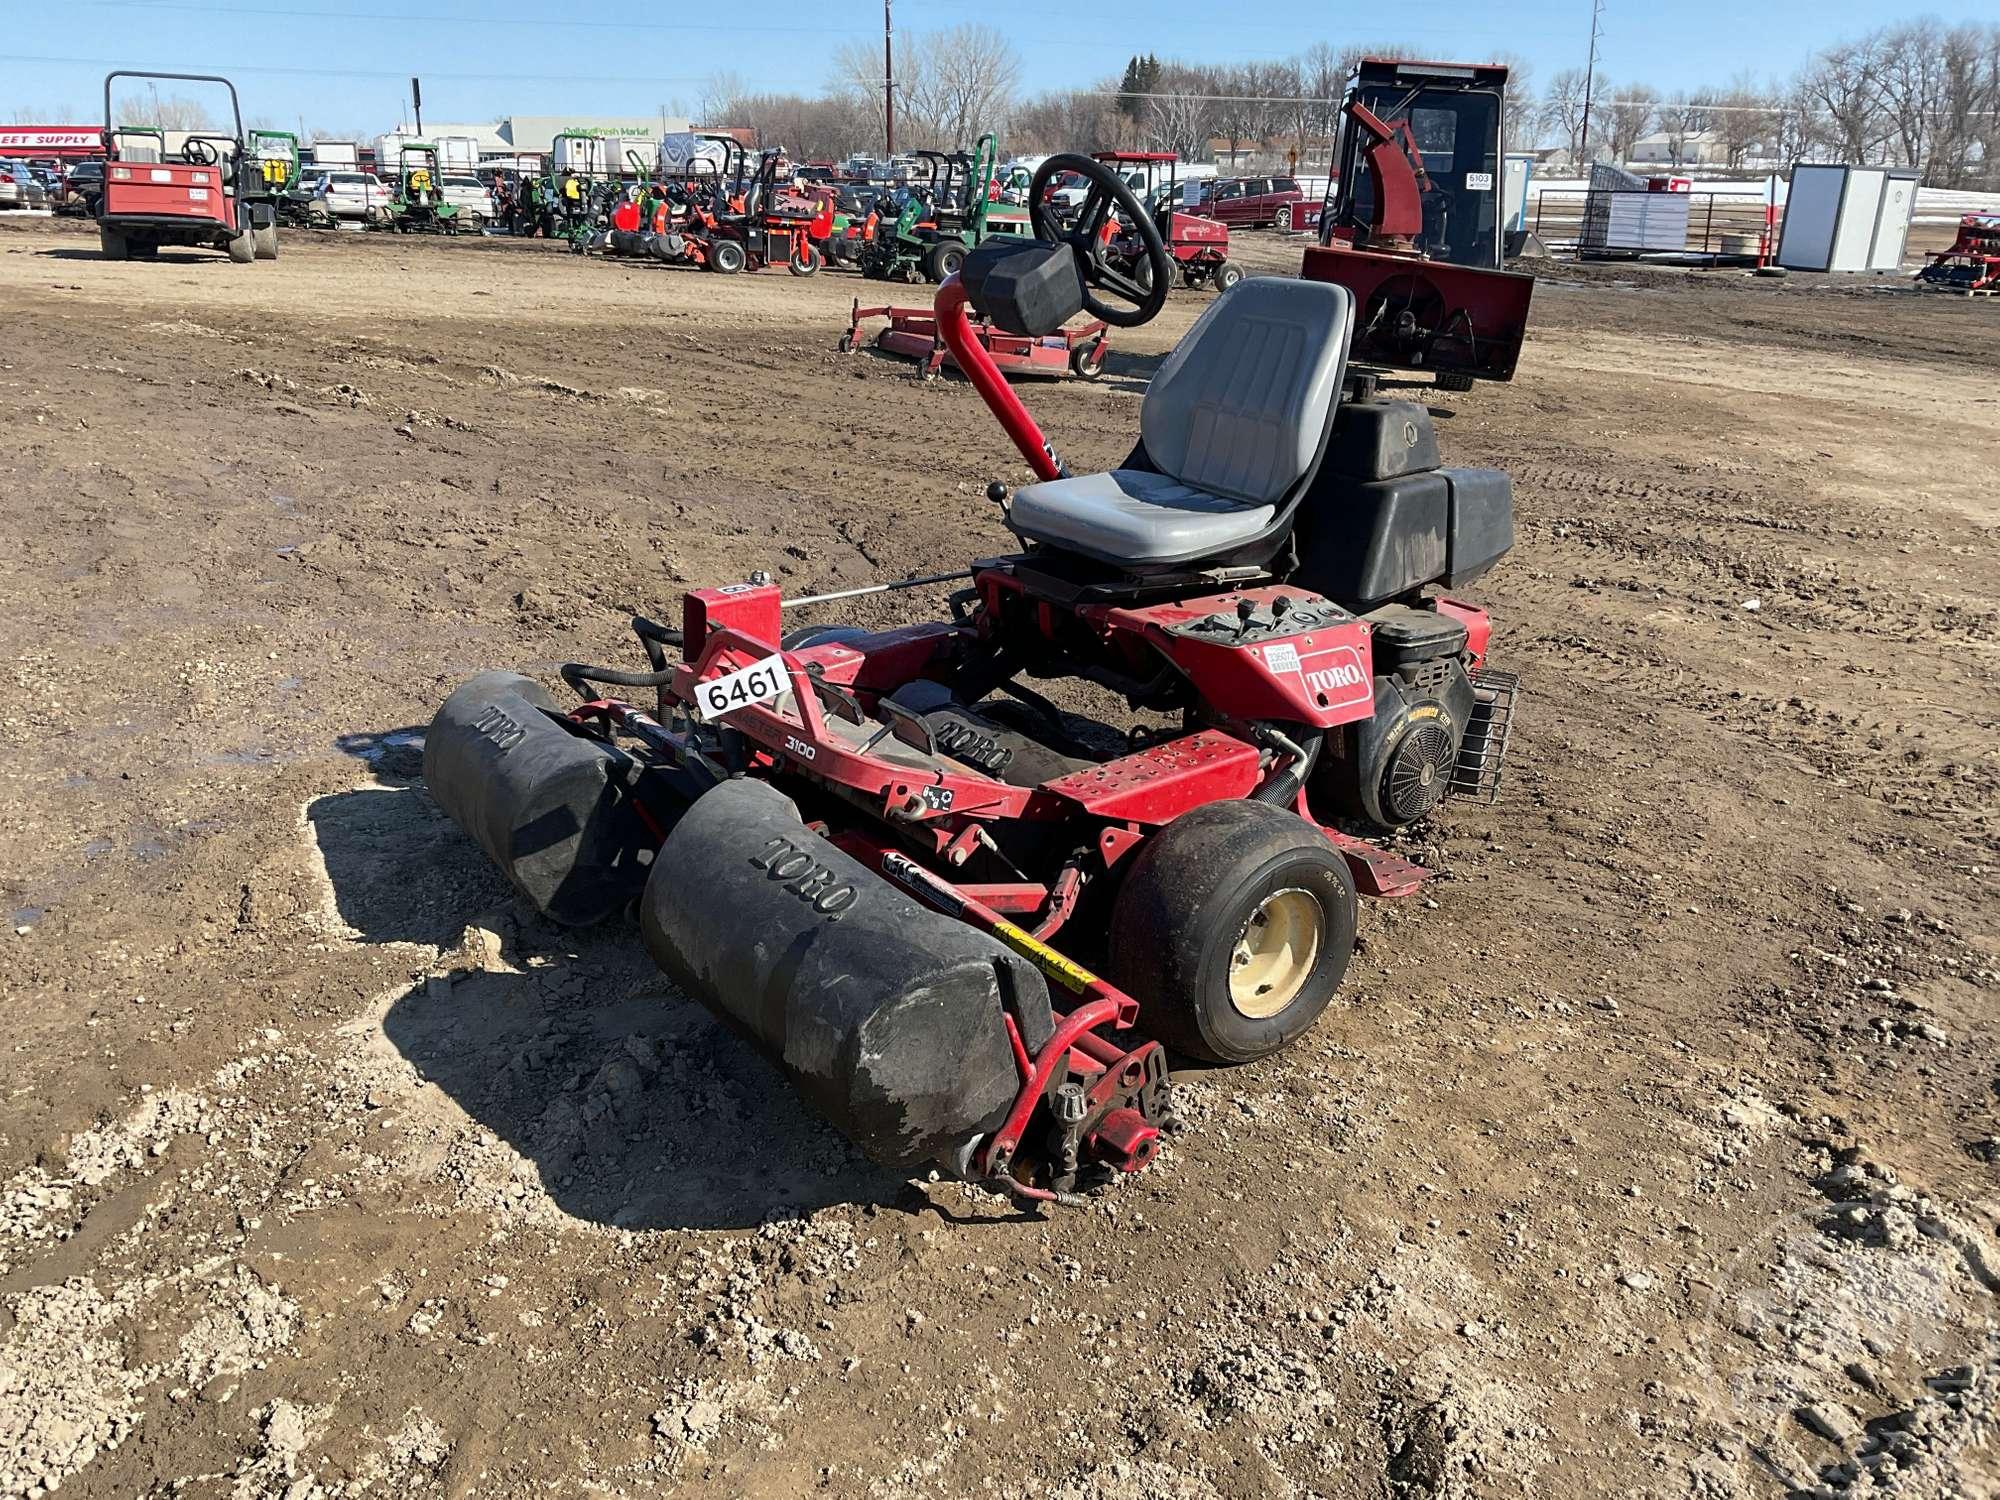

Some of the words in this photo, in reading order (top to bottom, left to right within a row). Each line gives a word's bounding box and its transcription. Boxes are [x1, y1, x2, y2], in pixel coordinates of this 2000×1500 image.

[36, 136, 89, 144] SUPPLY
[621, 127, 649, 136] Market
[708, 666, 780, 711] 6461
[471, 703, 529, 752] TORO
[784, 734, 816, 761] 3100
[936, 721, 1013, 770] TORO
[747, 838, 859, 914] TORO
